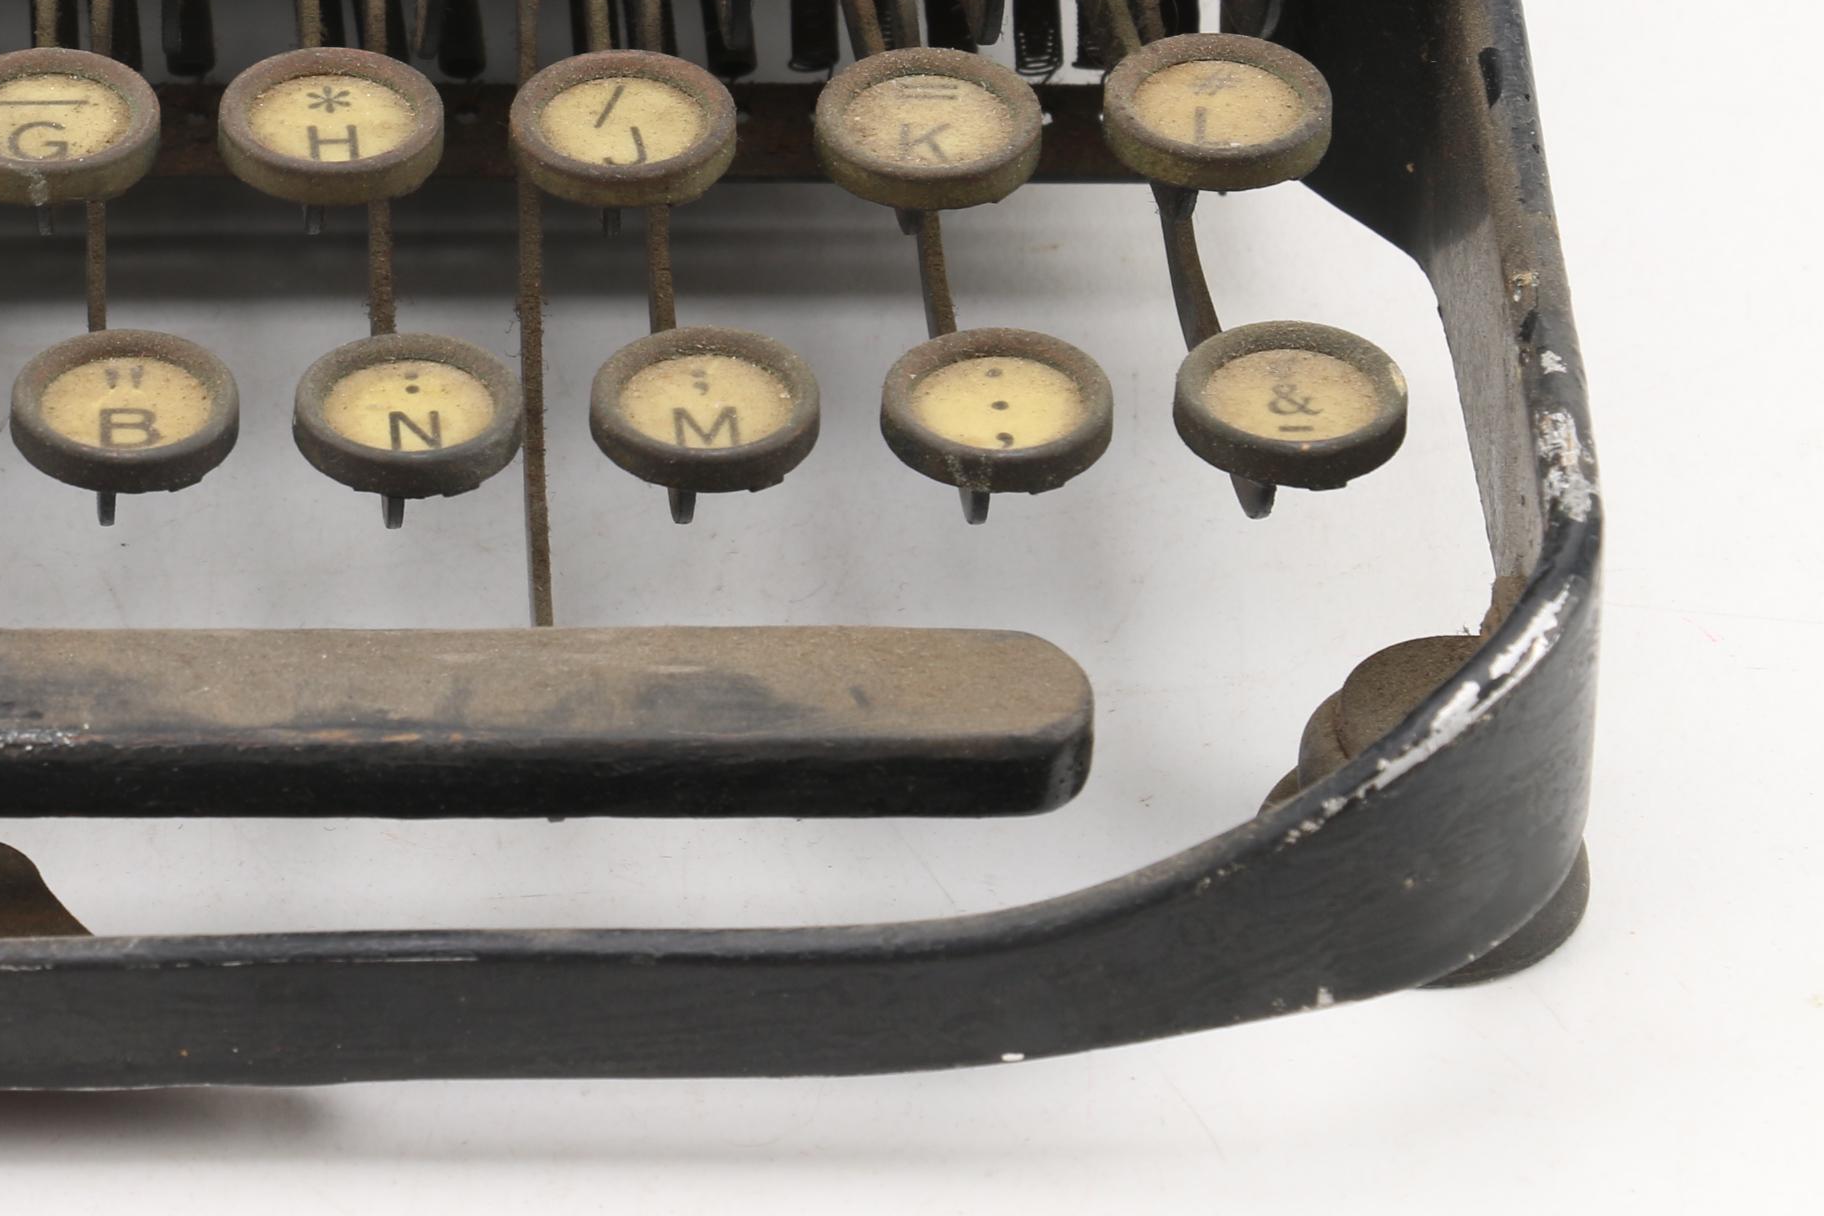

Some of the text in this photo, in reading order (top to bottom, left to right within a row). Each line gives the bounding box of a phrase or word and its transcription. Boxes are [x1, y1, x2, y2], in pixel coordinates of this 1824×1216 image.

[7, 121, 73, 161] G
[307, 125, 360, 161] H
[603, 126, 648, 165] J
[1268, 385, 1324, 415] &
[100, 408, 160, 447] B
[388, 411, 442, 450] N
[671, 406, 740, 446] M
